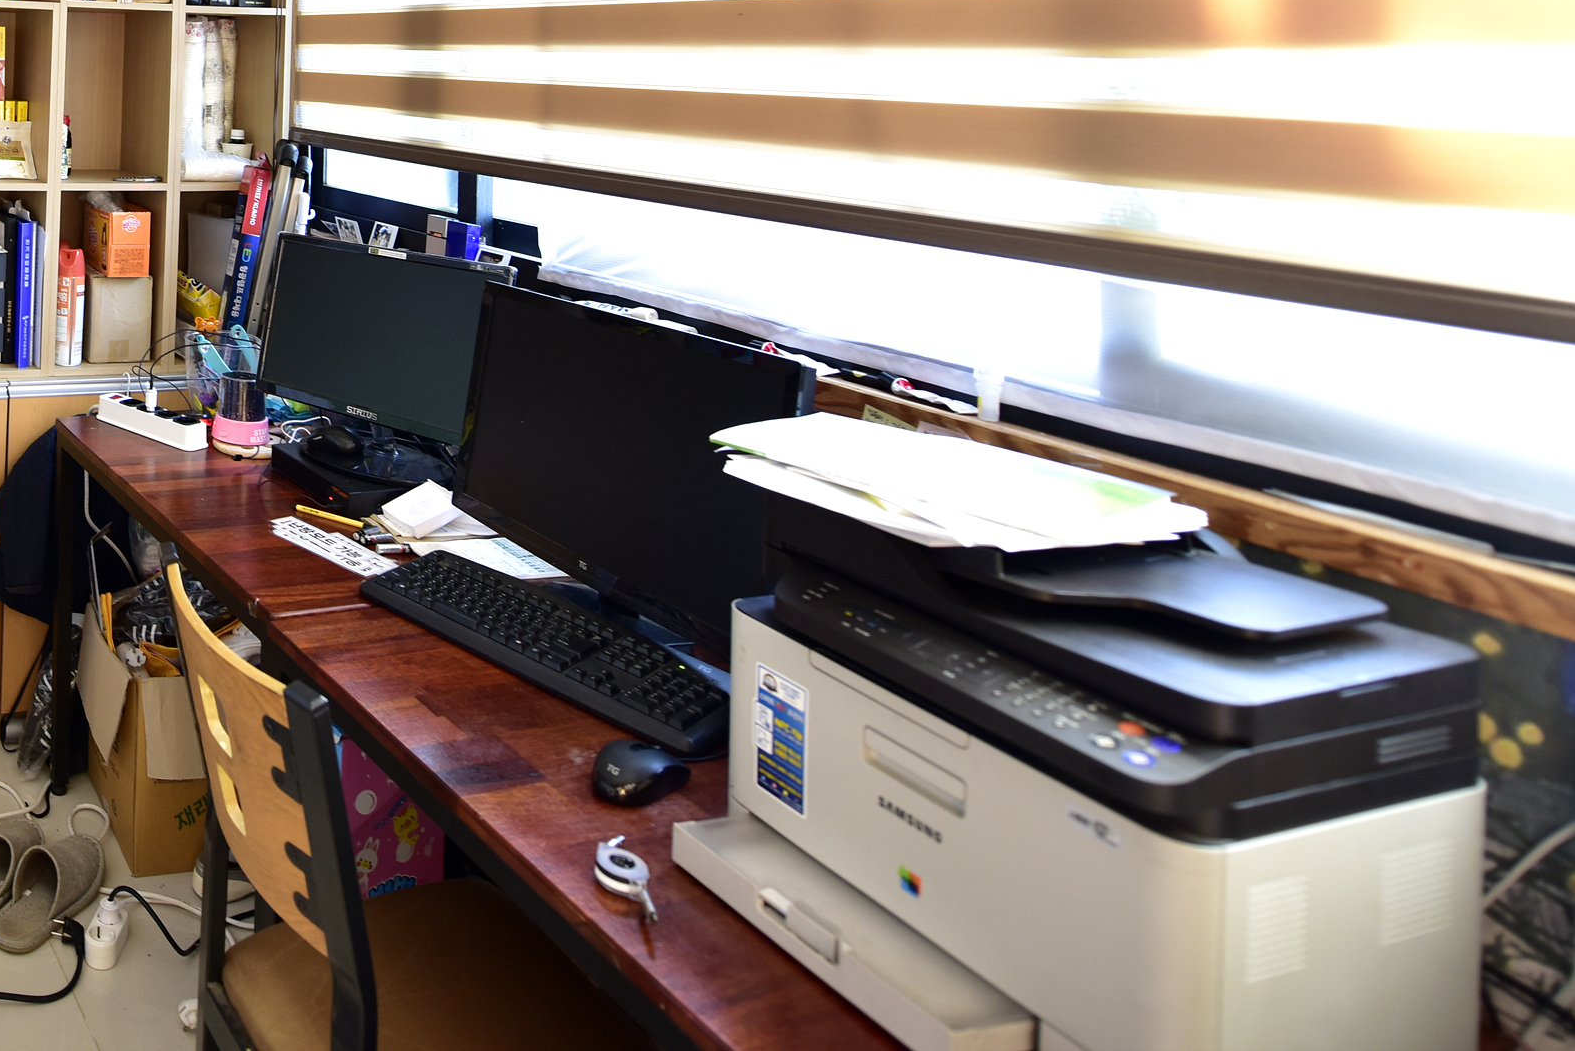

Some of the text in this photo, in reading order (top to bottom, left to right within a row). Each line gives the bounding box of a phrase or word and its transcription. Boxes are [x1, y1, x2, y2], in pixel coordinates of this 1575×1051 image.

[241, 242, 253, 263] LED
[346, 405, 378, 421] SIRIUS
[288, 522, 363, 559] 난방모드 가능
[578, 559, 588, 571] TG
[697, 664, 712, 674] TG
[606, 763, 621, 776] TG
[877, 795, 944, 844] SAMSUNG
